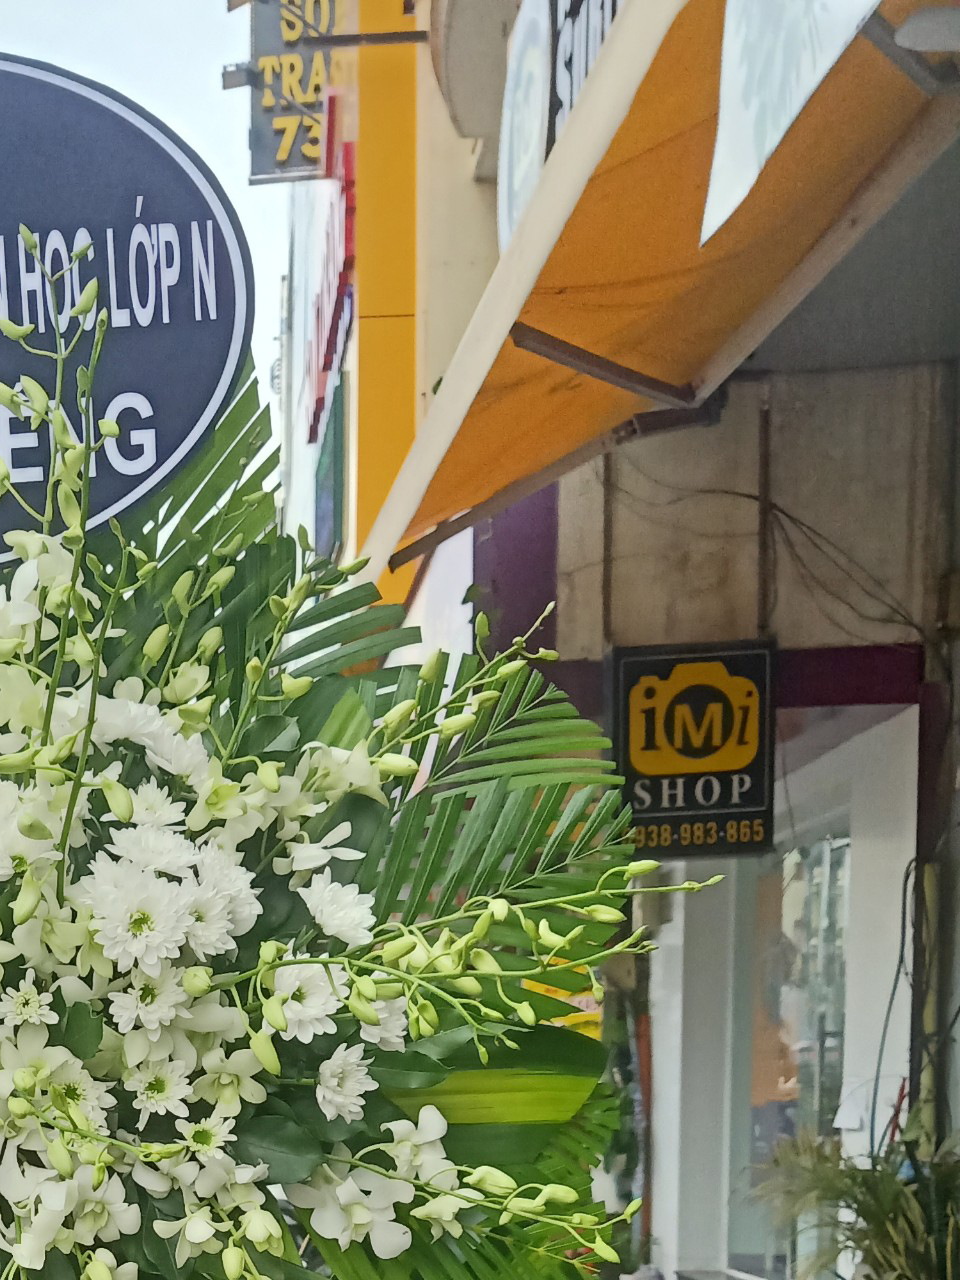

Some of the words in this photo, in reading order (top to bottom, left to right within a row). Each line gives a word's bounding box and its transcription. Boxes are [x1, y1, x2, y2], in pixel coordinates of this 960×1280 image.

[106, 195, 181, 328] LỚP
[191, 219, 217, 321] N
[633, 774, 752, 810] SHOP
